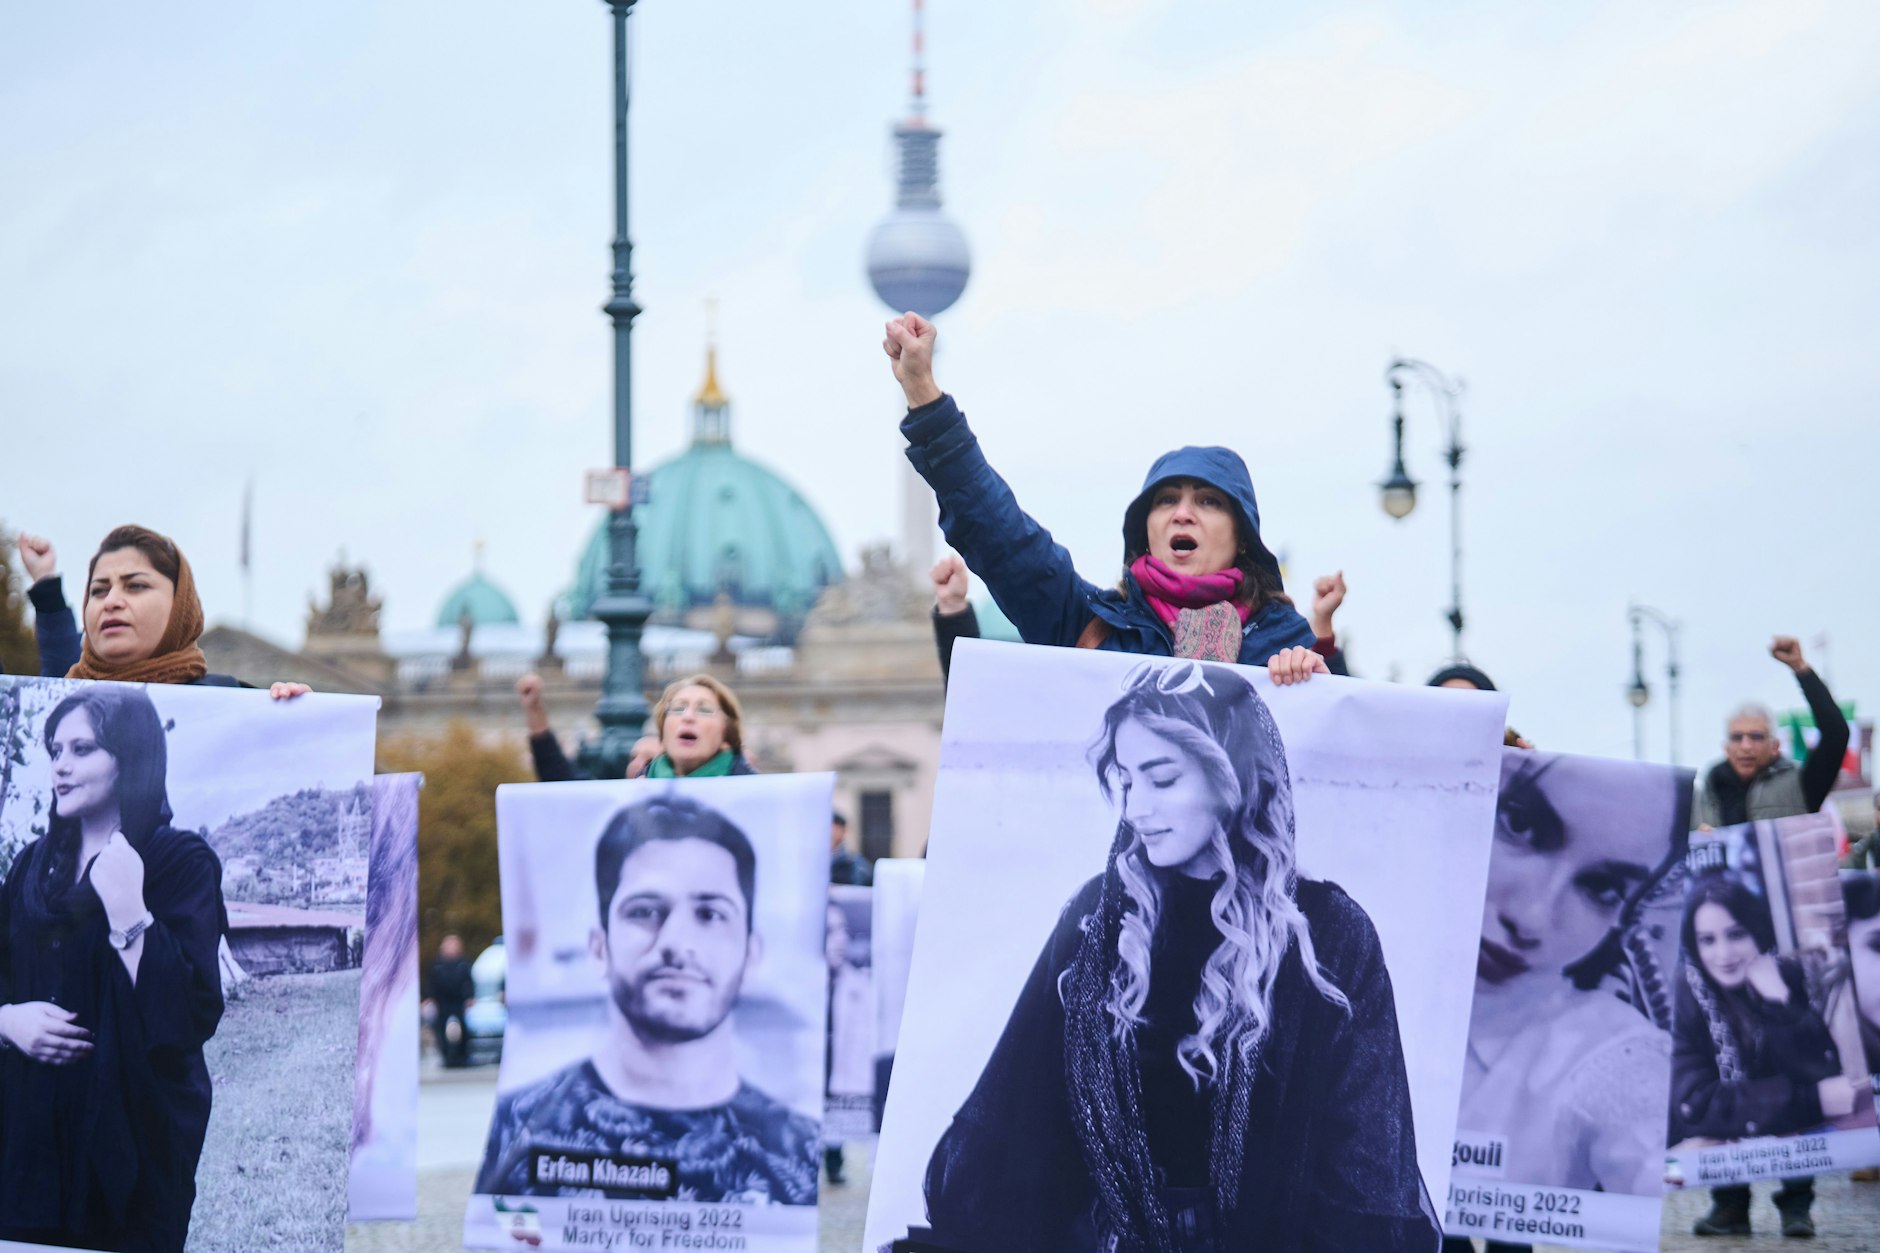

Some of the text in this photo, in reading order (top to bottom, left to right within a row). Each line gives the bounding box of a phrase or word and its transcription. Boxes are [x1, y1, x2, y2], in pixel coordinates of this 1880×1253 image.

[1794, 1137, 1827, 1153] 2022
[537, 1155, 671, 1190] Erfan Khazaie
[1533, 1191, 1581, 1215] 2022
[567, 1203, 743, 1231] Iran Uprising 2022
[1459, 1207, 1487, 1229] for
[1494, 1211, 1584, 1238] Freedom
[562, 1226, 747, 1250] Martyr for Freedom
